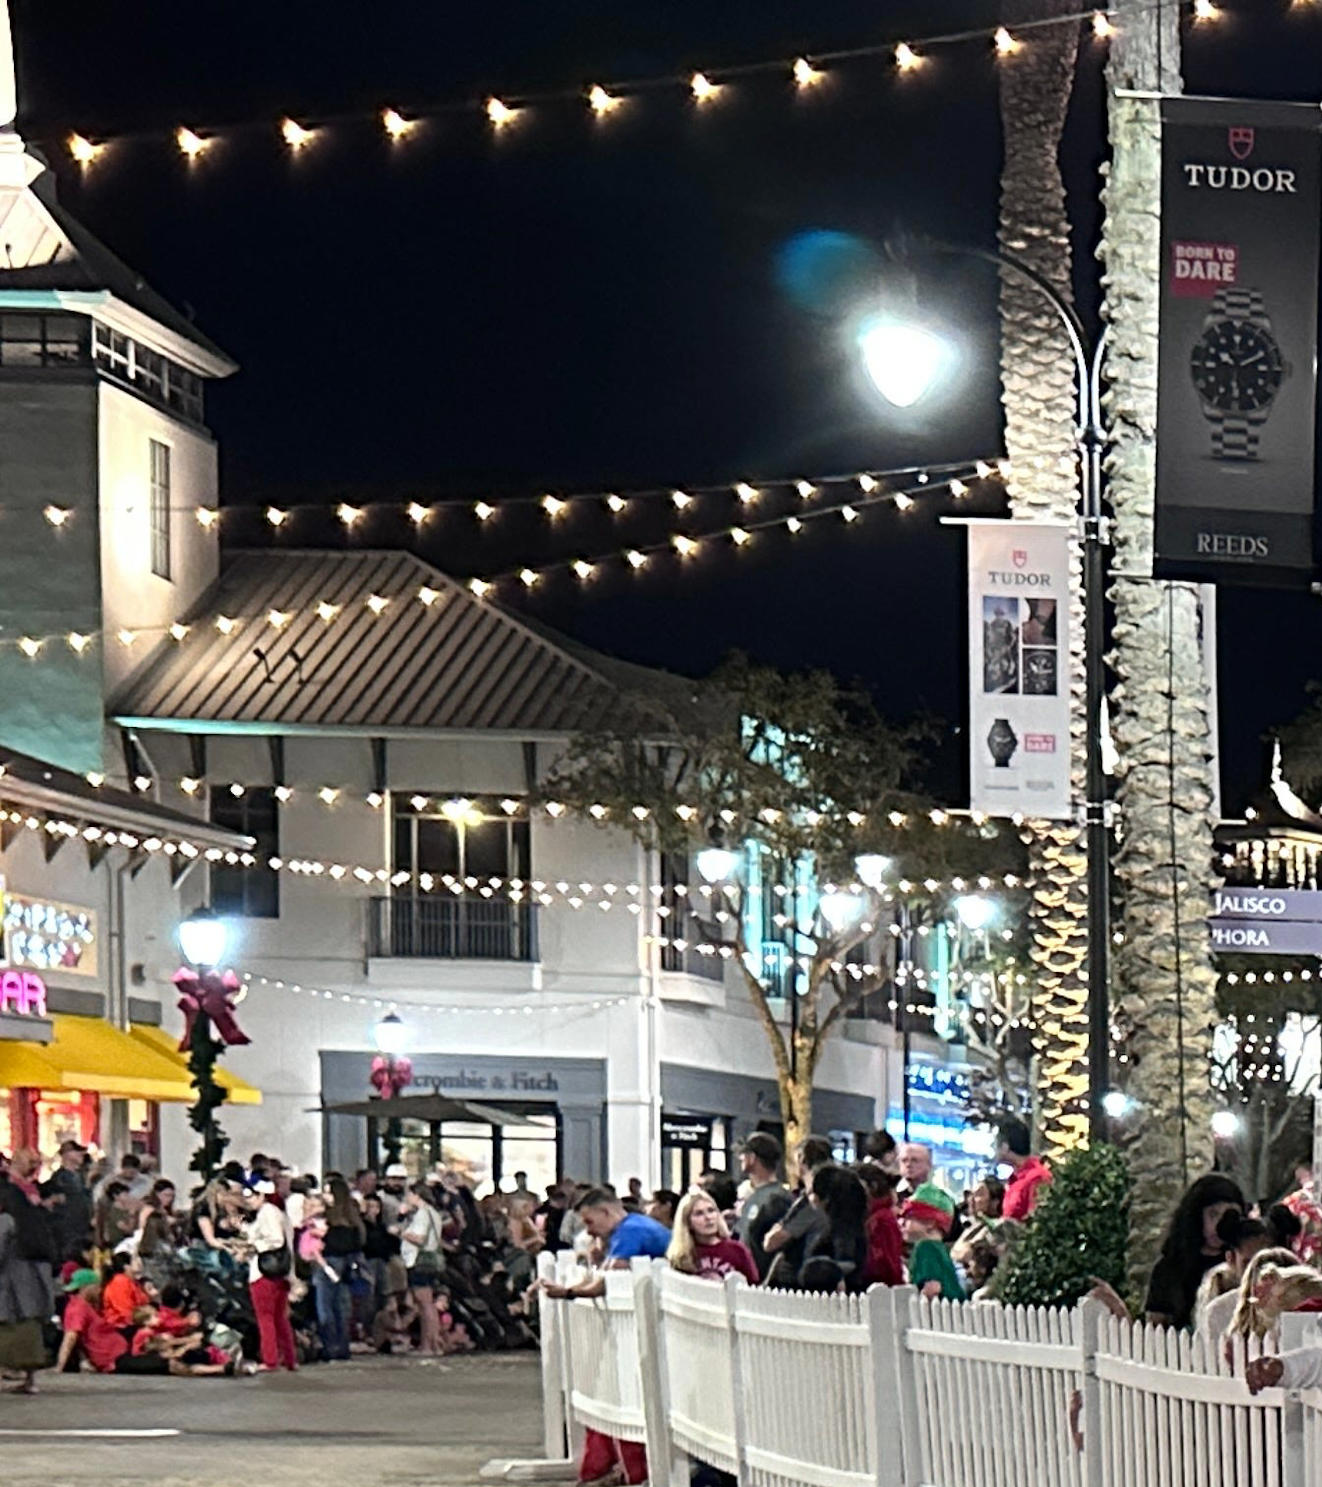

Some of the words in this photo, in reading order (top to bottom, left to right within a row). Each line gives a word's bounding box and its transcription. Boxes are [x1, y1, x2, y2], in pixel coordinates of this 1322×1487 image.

[1184, 164, 1297, 193] TUDOR
[1175, 245, 1214, 259] BORN
[1216, 247, 1236, 261] TO
[1175, 259, 1236, 282] DARE
[1197, 532, 1270, 557] REEDS
[988, 570, 1052, 587] TUDOR
[1215, 892, 1286, 915] JALISCO
[0, 971, 47, 1017] AR
[411, 1068, 487, 1089] crombie
[511, 1070, 559, 1092] Fitch
